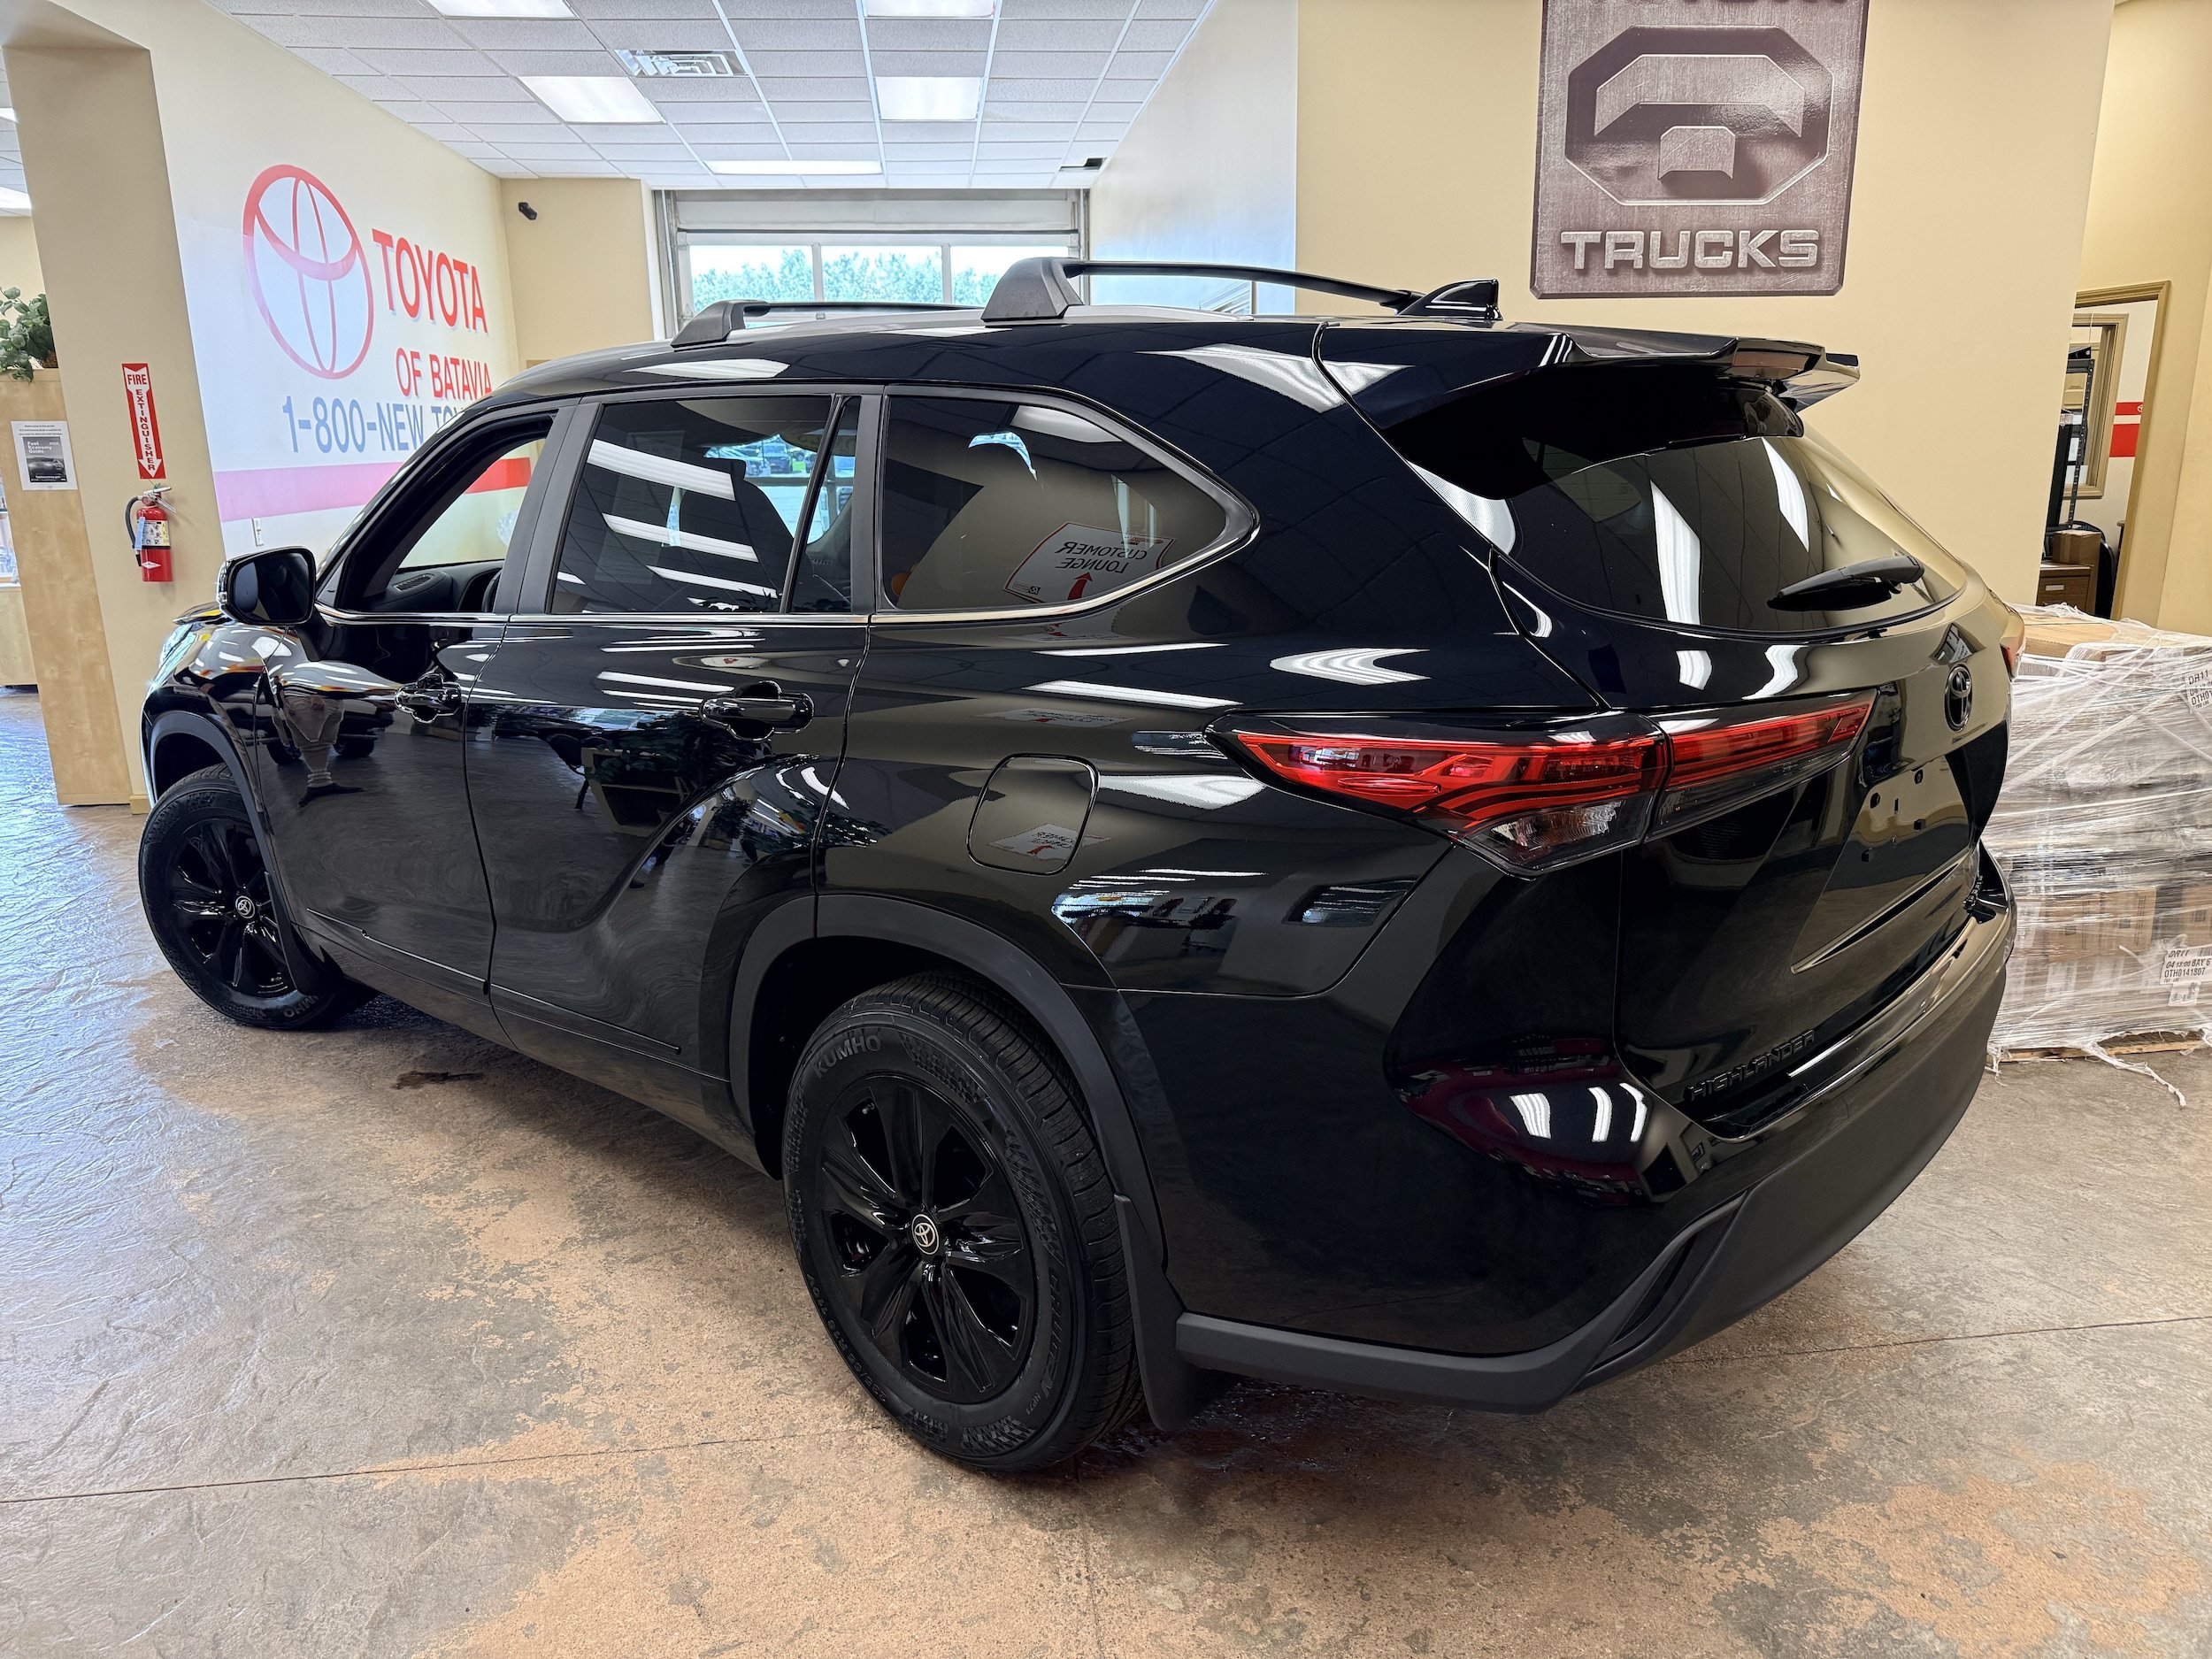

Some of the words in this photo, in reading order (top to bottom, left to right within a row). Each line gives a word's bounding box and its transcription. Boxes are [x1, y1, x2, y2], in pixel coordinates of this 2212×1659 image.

[1560, 228, 1820, 270] TRUCKS
[372, 228, 488, 334] TOYOTA
[127, 373, 148, 386] FIRE
[396, 347, 421, 397] OF
[429, 354, 492, 401] BATAVIA
[135, 388, 156, 471] EXTINGUISHER
[282, 395, 424, 453] 1-800-NEW
[2168, 949, 2190, 958] DR11
[2191, 958, 2205, 967] BAY
[812, 1034, 882, 1080] KUMHO
[1684, 1029, 1815, 1102] HIGHLANDER
